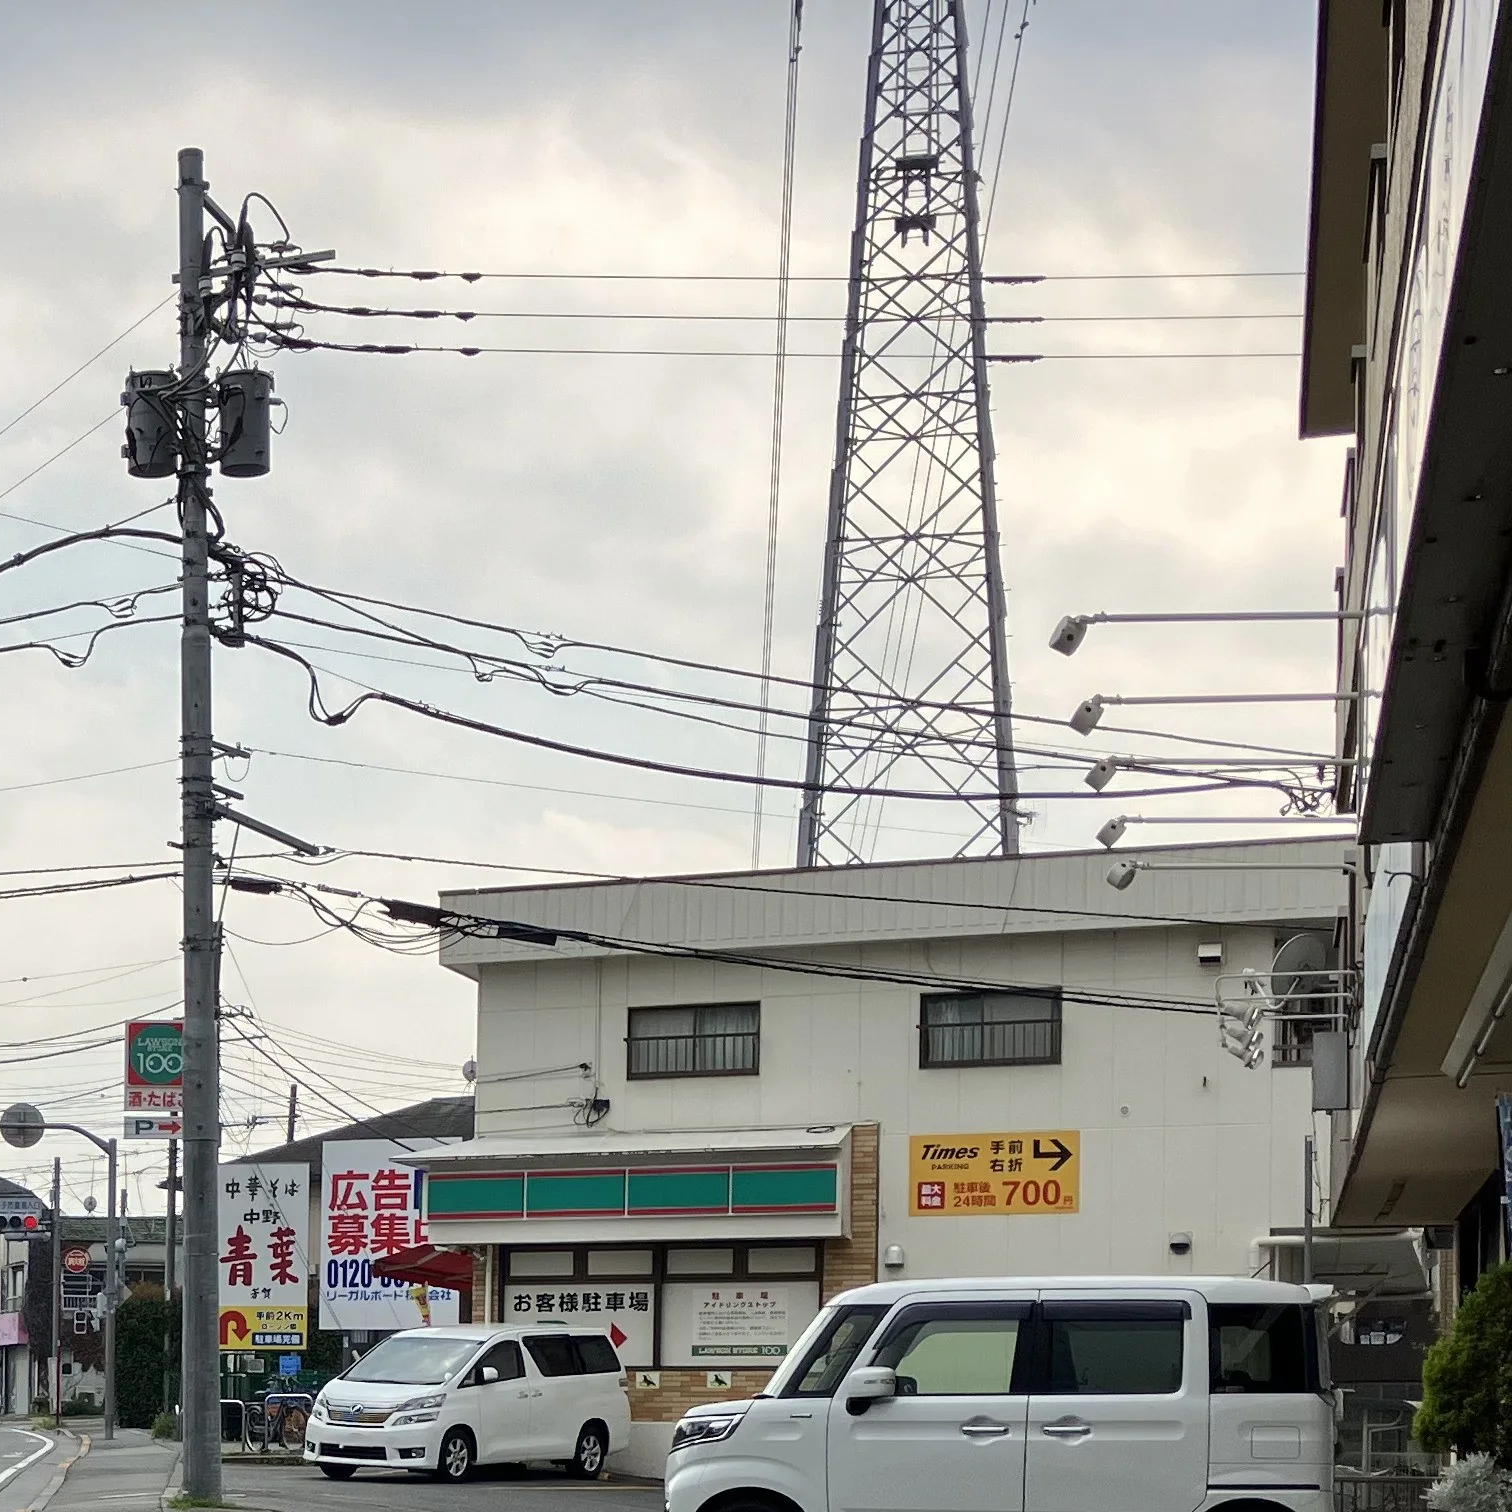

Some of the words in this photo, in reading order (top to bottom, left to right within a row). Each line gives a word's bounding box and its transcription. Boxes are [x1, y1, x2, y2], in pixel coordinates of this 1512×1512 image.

[137, 1038, 182, 1046] LAWSON
[136, 1053, 182, 1073] 100
[135, 1120, 153, 1134] P
[921, 1144, 980, 1160] Times
[990, 1139, 1024, 1154] 手前
[990, 1158, 1023, 1172] 右折
[226, 1174, 301, 1202] 中華そば
[329, 1169, 411, 1211] 広告
[954, 1182, 991, 1194] 駐車後
[1002, 1180, 1060, 1206] 700
[953, 1195, 996, 1207] 24時間
[243, 1208, 280, 1225] 中野
[219, 1225, 299, 1287] 青葉
[326, 1289, 451, 1301] リーガルボード会社
[513, 1291, 649, 1313] お客様駐車場
[703, 1301, 777, 1309] アイドリングストップ
[761, 1346, 781, 1355] 100
